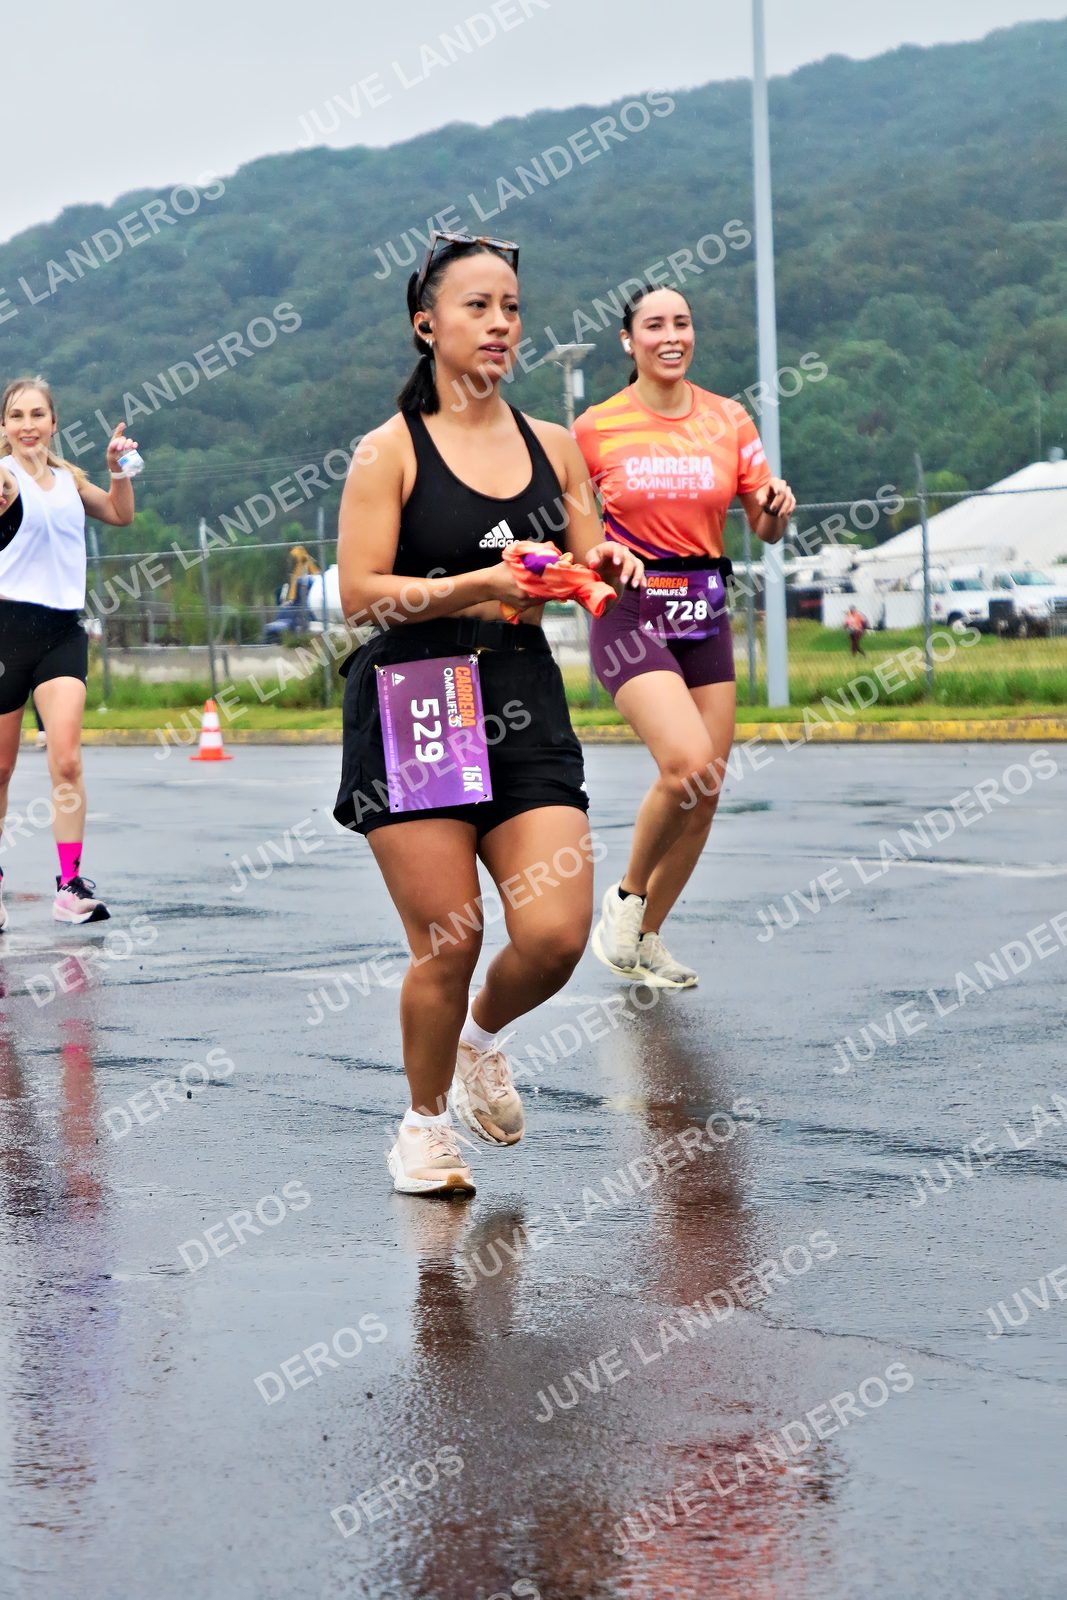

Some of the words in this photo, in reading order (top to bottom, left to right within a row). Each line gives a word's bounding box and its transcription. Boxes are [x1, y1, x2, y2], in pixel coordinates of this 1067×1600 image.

[625, 456, 714, 476] CARRERA
[627, 477, 697, 490] OMNILIFE
[646, 588, 679, 596] OMNILIFE
[647, 576, 689, 588] CARRERA
[665, 600, 708, 620] 728
[444, 667, 458, 716] OMNILIFE
[454, 666, 476, 727] CARRERA
[411, 698, 444, 763] 529
[462, 765, 484, 792] 15K
